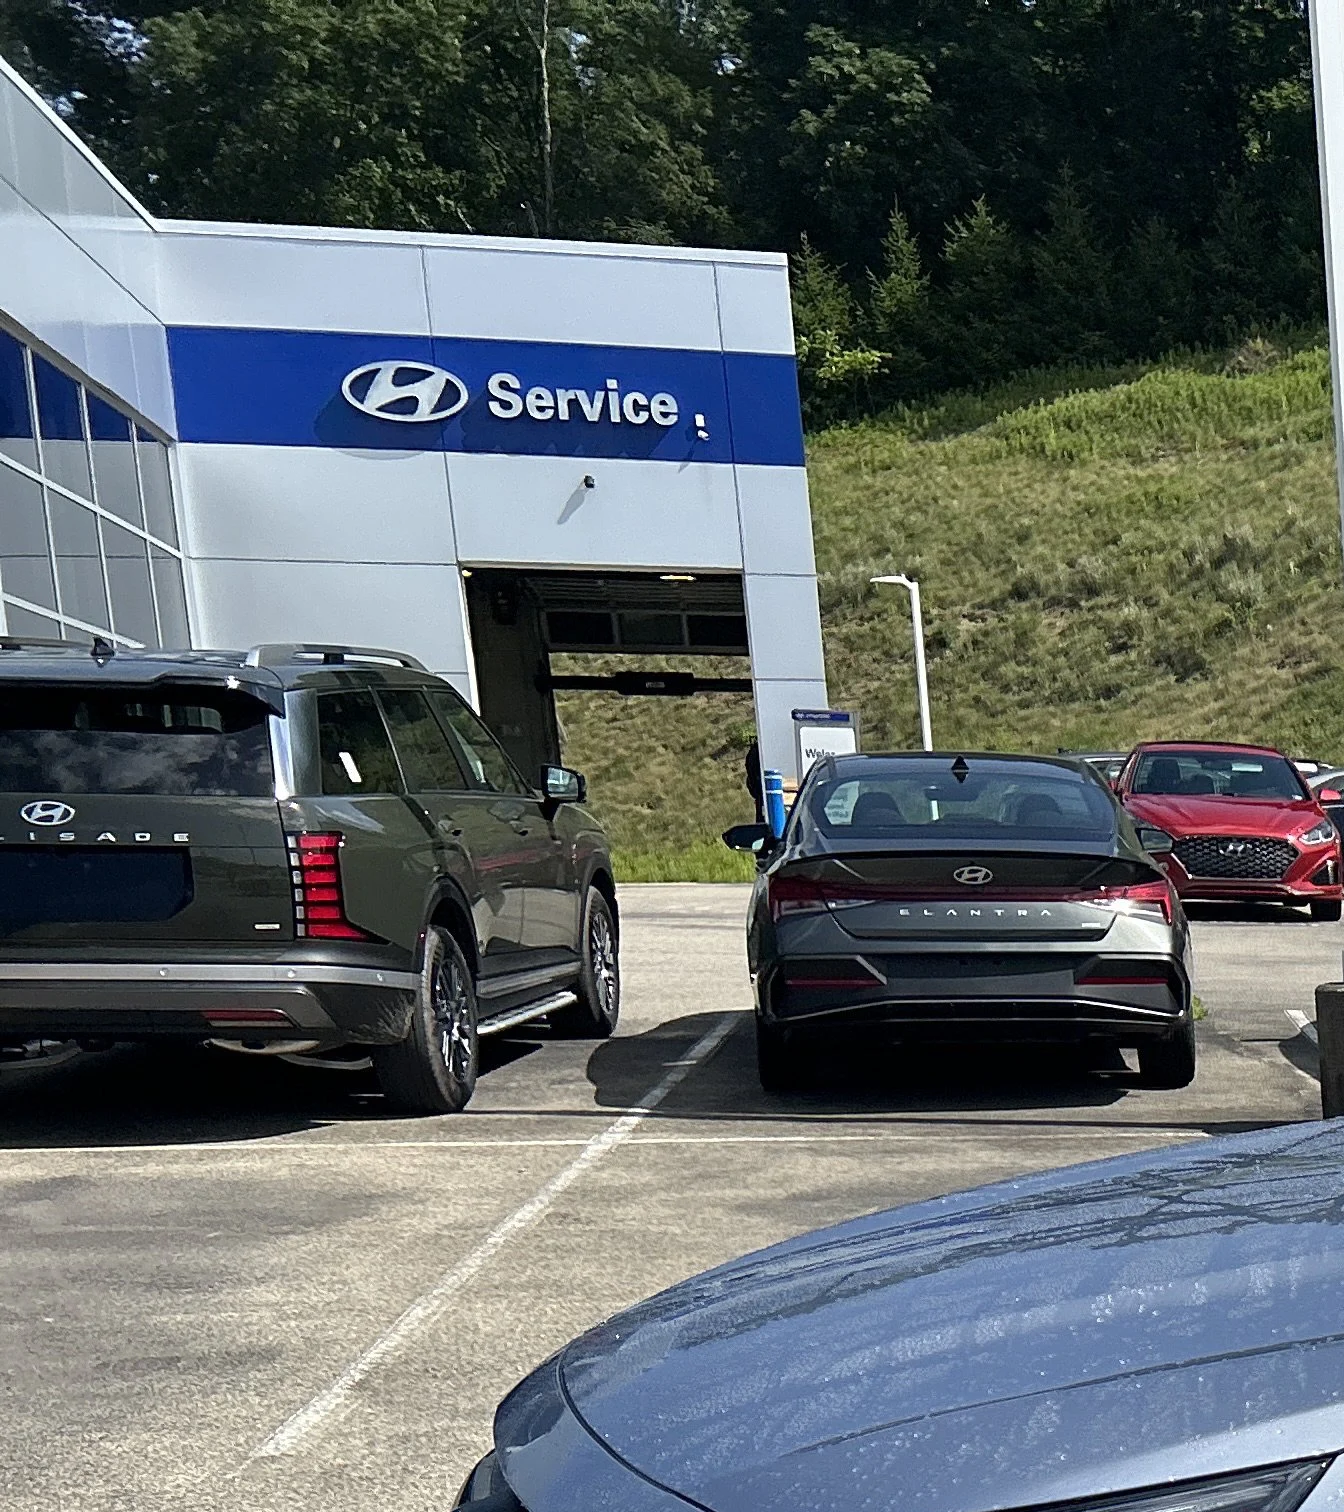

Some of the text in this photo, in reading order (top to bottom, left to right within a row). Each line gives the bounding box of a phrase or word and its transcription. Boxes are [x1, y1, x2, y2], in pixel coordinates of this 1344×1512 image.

[487, 372, 679, 426] Service
[0, 831, 190, 843] ISADE
[899, 908, 1052, 917] ELANTRA
